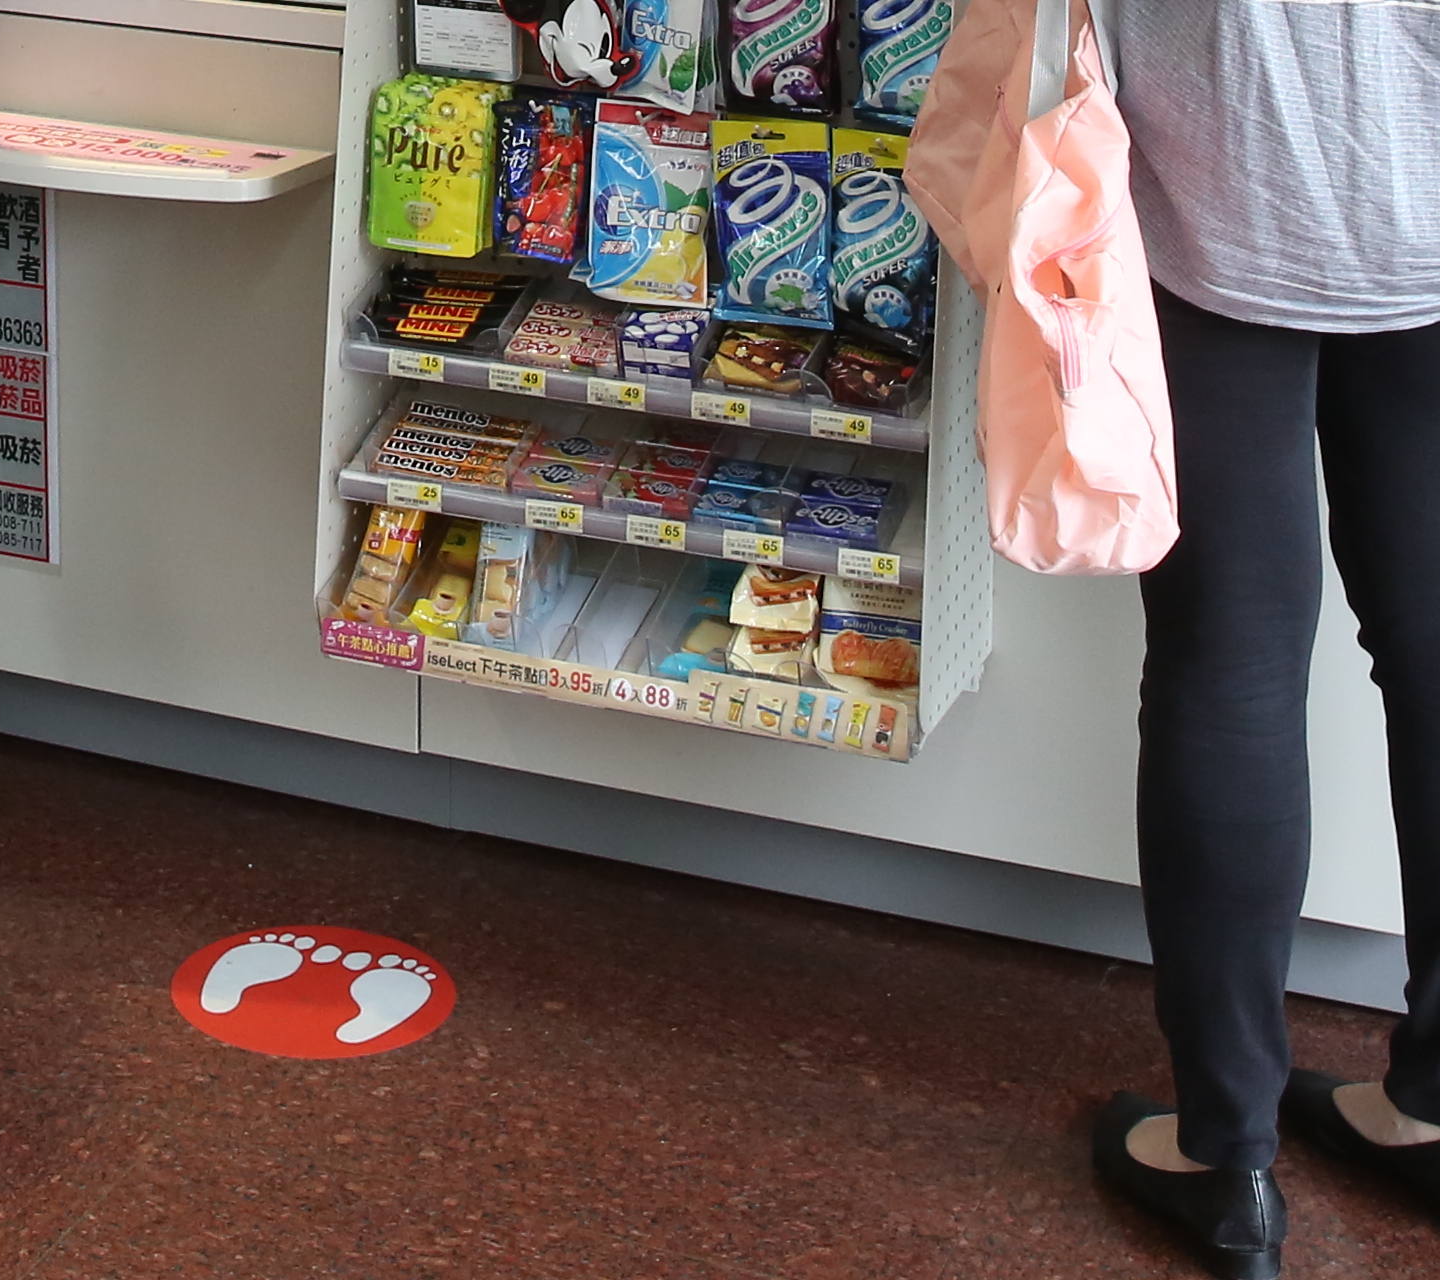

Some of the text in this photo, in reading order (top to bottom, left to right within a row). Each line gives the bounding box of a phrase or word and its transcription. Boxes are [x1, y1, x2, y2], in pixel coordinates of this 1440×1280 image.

[631, 10, 691, 49] Extra
[772, 40, 817, 69] SUPER
[606, 192, 701, 234] Extra
[728, 189, 818, 290] Airwaves
[863, 259, 908, 286] SUPER
[428, 288, 490, 300] MINE
[413, 305, 475, 318] MINE
[403, 320, 463, 333] MINE
[424, 357, 438, 367] 15
[524, 374, 538, 384] 49
[624, 388, 639, 399] 49
[412, 403, 489, 425] mentos
[729, 403, 744, 414] 49
[850, 421, 865, 432] 49
[394, 429, 473, 450] mentos
[387, 441, 466, 461] mentos
[378, 454, 457, 477] mentos
[524, 465, 597, 484] eclipse
[423, 488, 437, 498] 25
[559, 506, 577, 522] 65
[797, 505, 875, 528] eclipse
[664, 526, 680, 537] 65
[762, 541, 777, 552] 65
[878, 559, 893, 570] 65
[428, 653, 477, 673] iseLect
